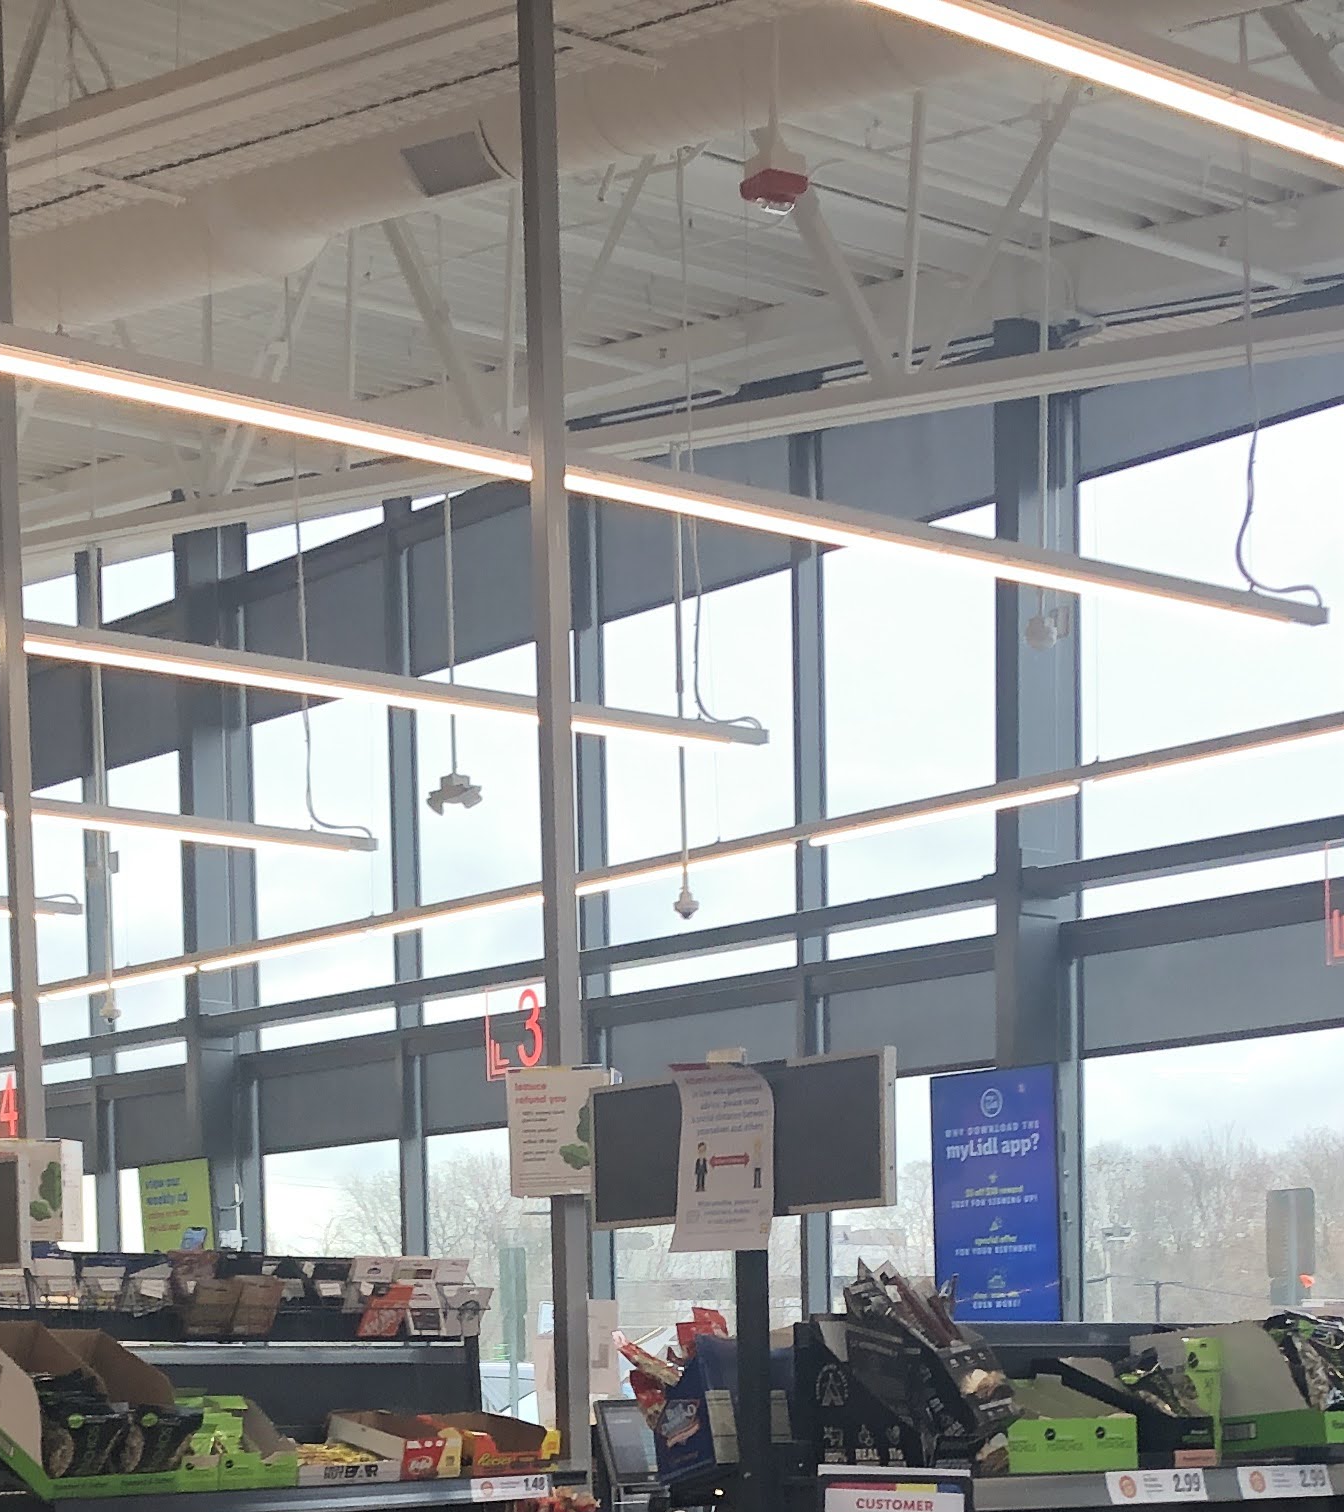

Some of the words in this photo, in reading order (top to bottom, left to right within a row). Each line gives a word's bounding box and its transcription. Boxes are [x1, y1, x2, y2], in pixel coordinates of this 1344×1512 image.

[517, 989, 543, 1066] 3
[0, 1074, 18, 1136] 4
[946, 1137, 999, 1162] myLidl
[1001, 1133, 1040, 1157] app?
[1172, 1473, 1200, 1492] 2.99
[1299, 1470, 1326, 1487] 2.99
[856, 1498, 933, 1511] CUSTOMER
